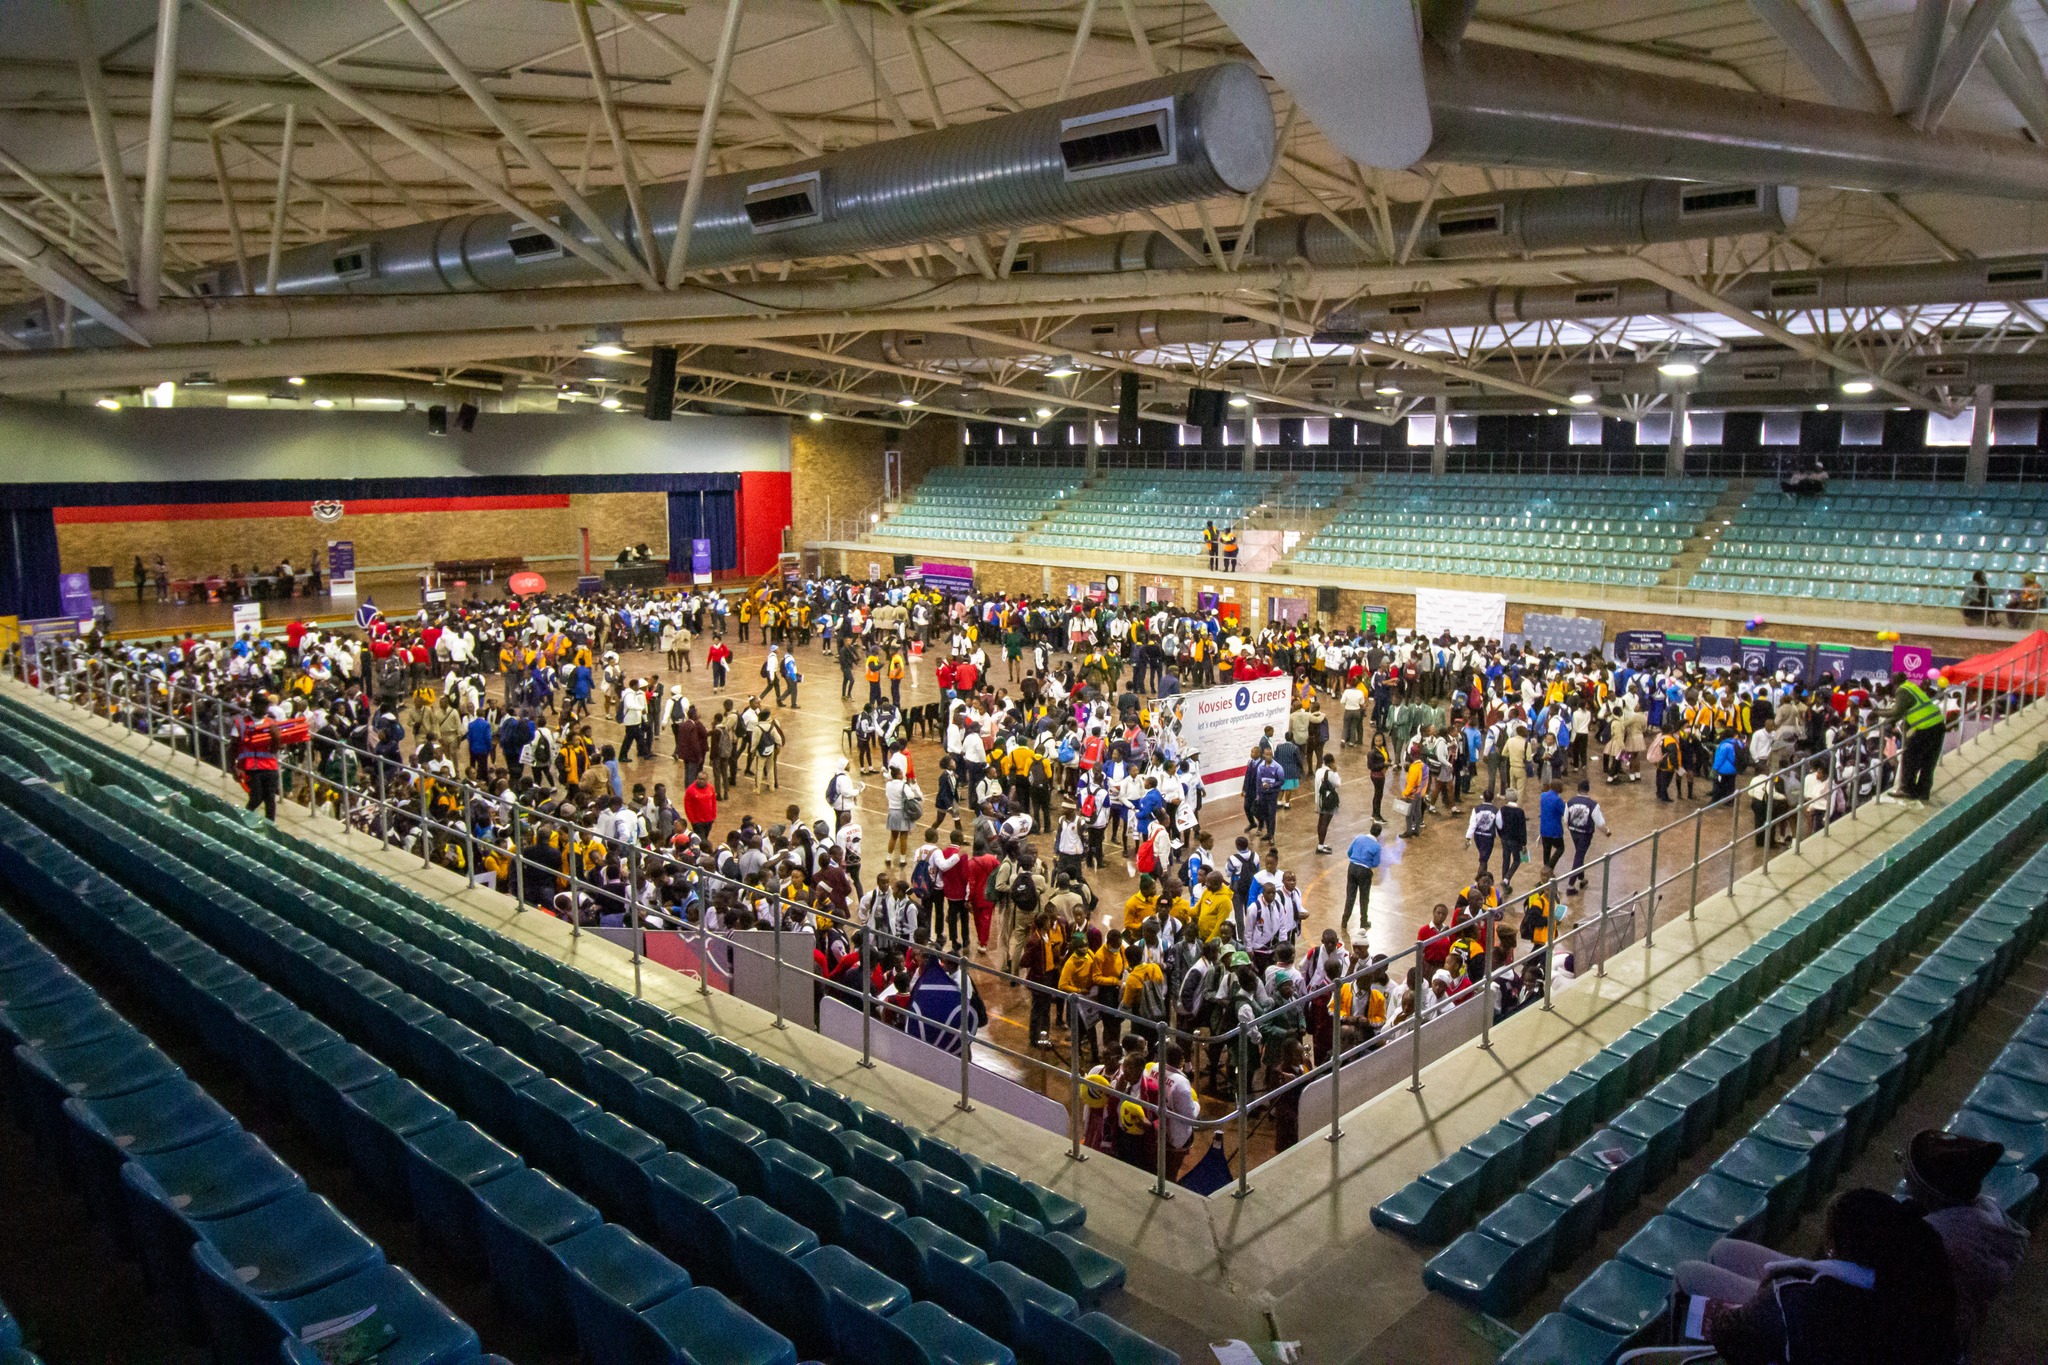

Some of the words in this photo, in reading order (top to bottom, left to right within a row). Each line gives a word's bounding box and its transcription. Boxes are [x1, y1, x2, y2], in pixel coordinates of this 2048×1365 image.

[1199, 697, 1233, 715] Kovsies
[1239, 693, 1246, 706] 2
[1251, 689, 1286, 704] Careers
[1198, 721, 1209, 731] let's
[1209, 719, 1229, 729] explore
[1230, 712, 1264, 724] opportunities
[1265, 707, 1285, 719] 2gether
